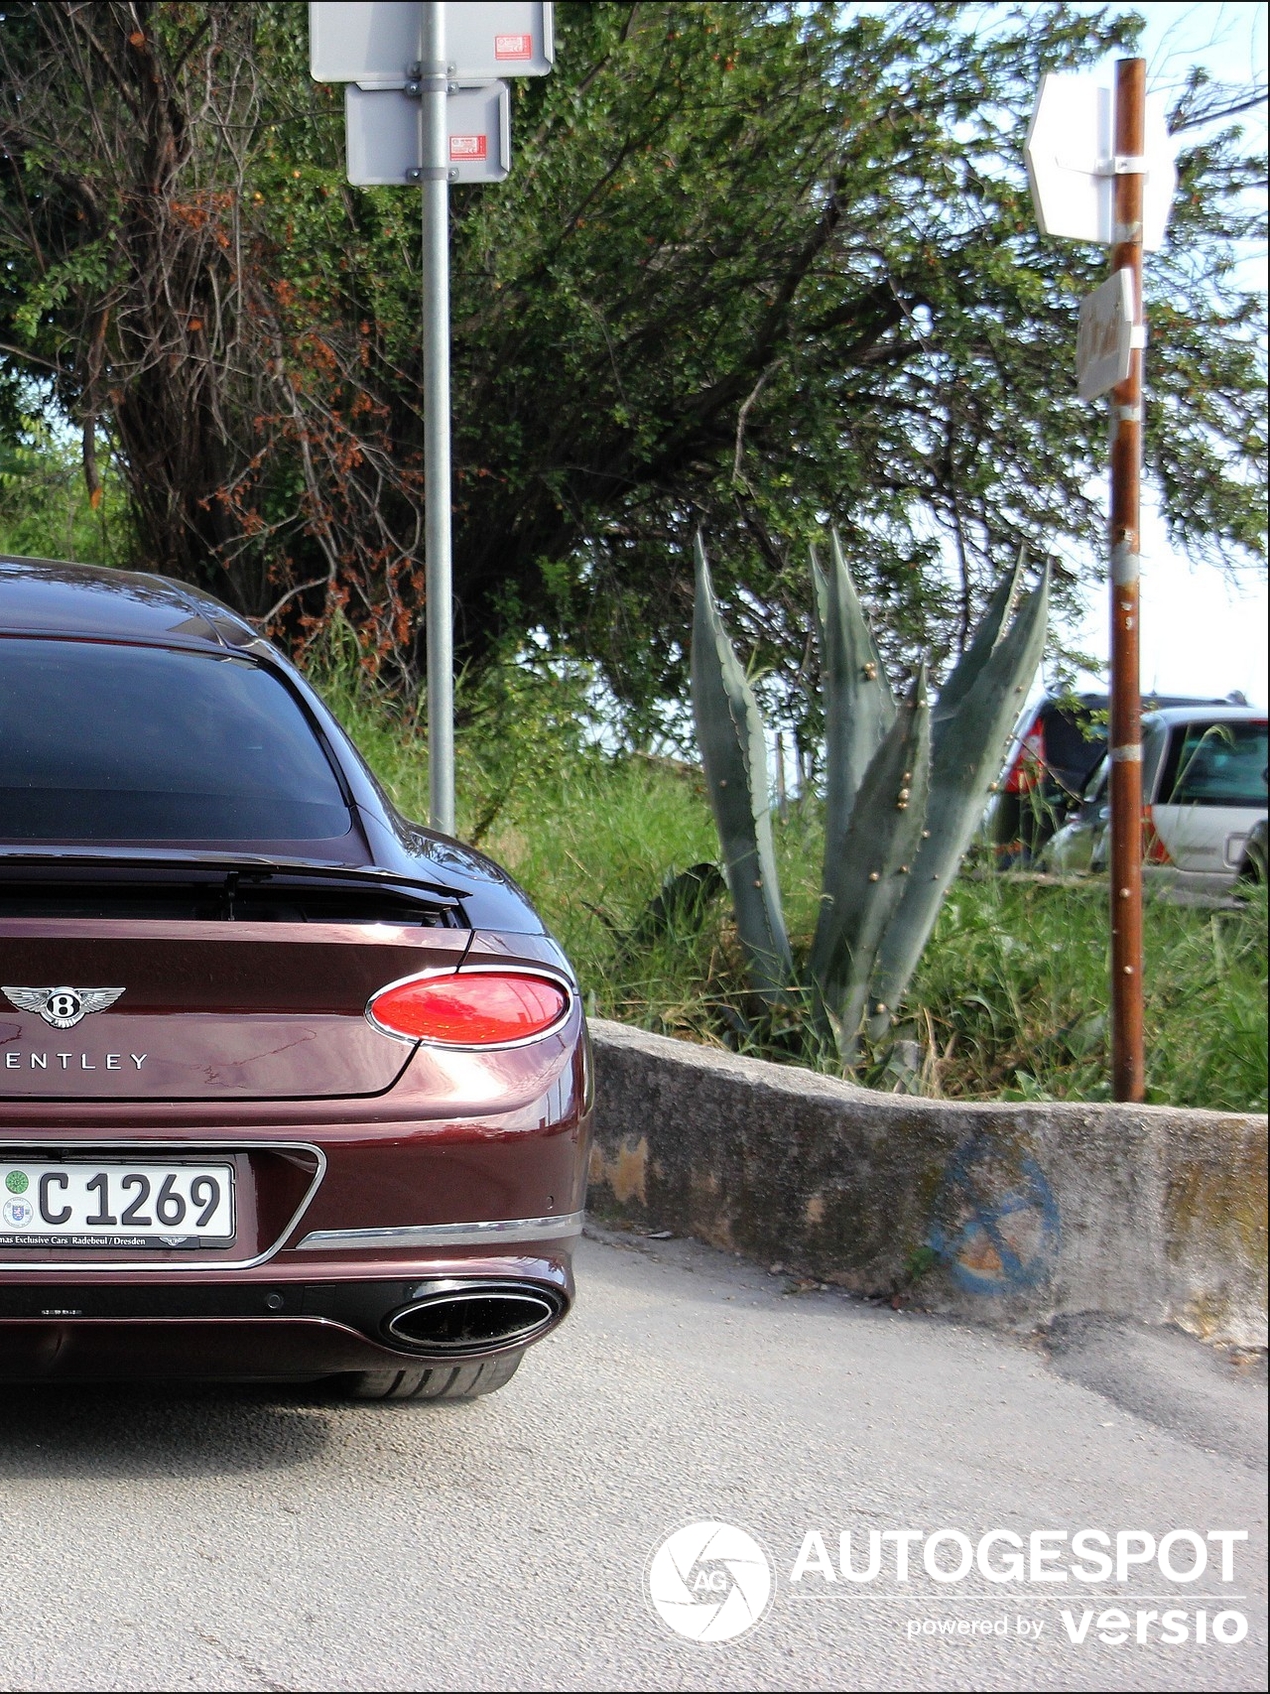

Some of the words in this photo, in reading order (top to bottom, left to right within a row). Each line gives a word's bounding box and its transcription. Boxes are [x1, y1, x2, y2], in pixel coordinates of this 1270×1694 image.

[39, 1172, 73, 1225] C
[86, 1173, 221, 1227] 1269
[15, 1235, 49, 1244] Exclusive
[50, 1236, 68, 1245] Cars
[72, 1236, 107, 1245] Radebeul
[113, 1237, 146, 1246] Dresden
